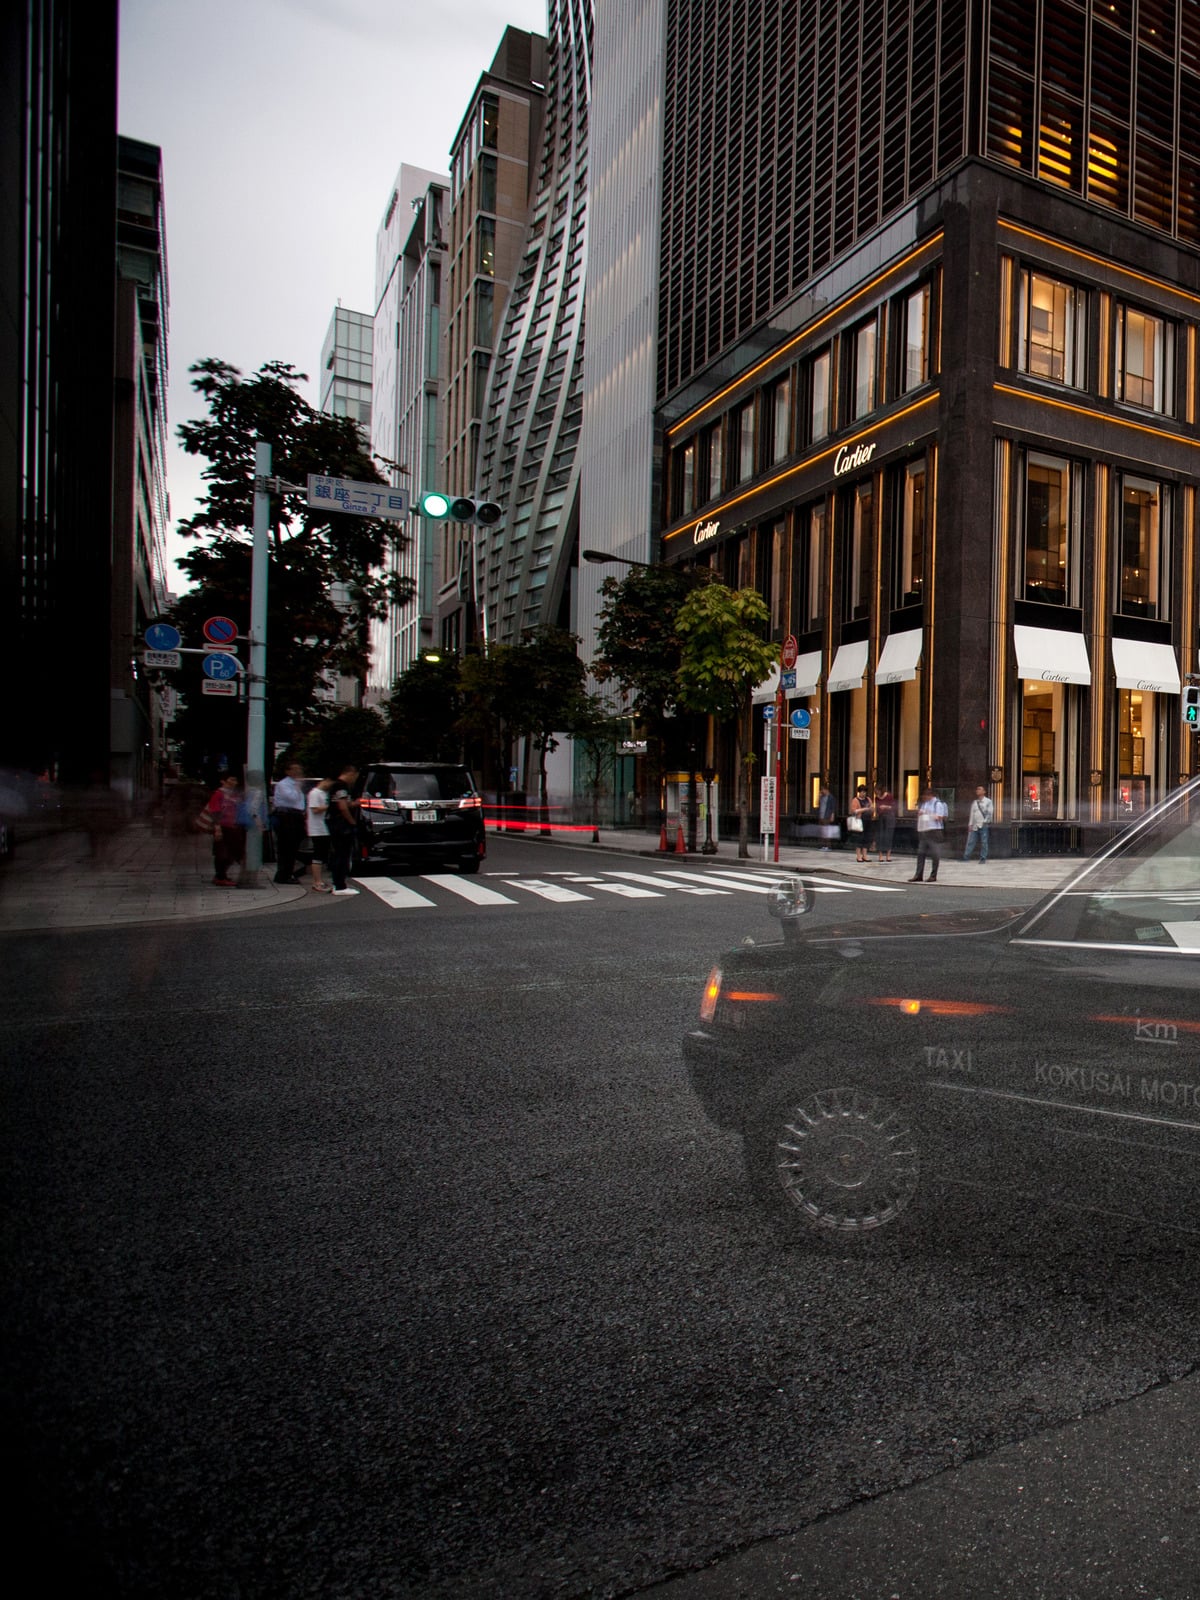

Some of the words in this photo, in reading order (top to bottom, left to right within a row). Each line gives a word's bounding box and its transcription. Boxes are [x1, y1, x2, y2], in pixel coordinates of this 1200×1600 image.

[833, 442, 877, 478] Cartier
[314, 484, 403, 511] 銀座二丁目
[342, 501, 368, 513] Ginza
[370, 505, 377, 513] 2
[693, 520, 721, 545] Cartier
[210, 660, 224, 676] P
[219, 668, 230, 677] 60
[1041, 669, 1071, 683] Cartier
[1136, 680, 1163, 692] Cartier
[1134, 1019, 1178, 1039] km
[923, 1046, 973, 1073] TAXI
[1034, 1061, 1131, 1098] KOKUSAI
